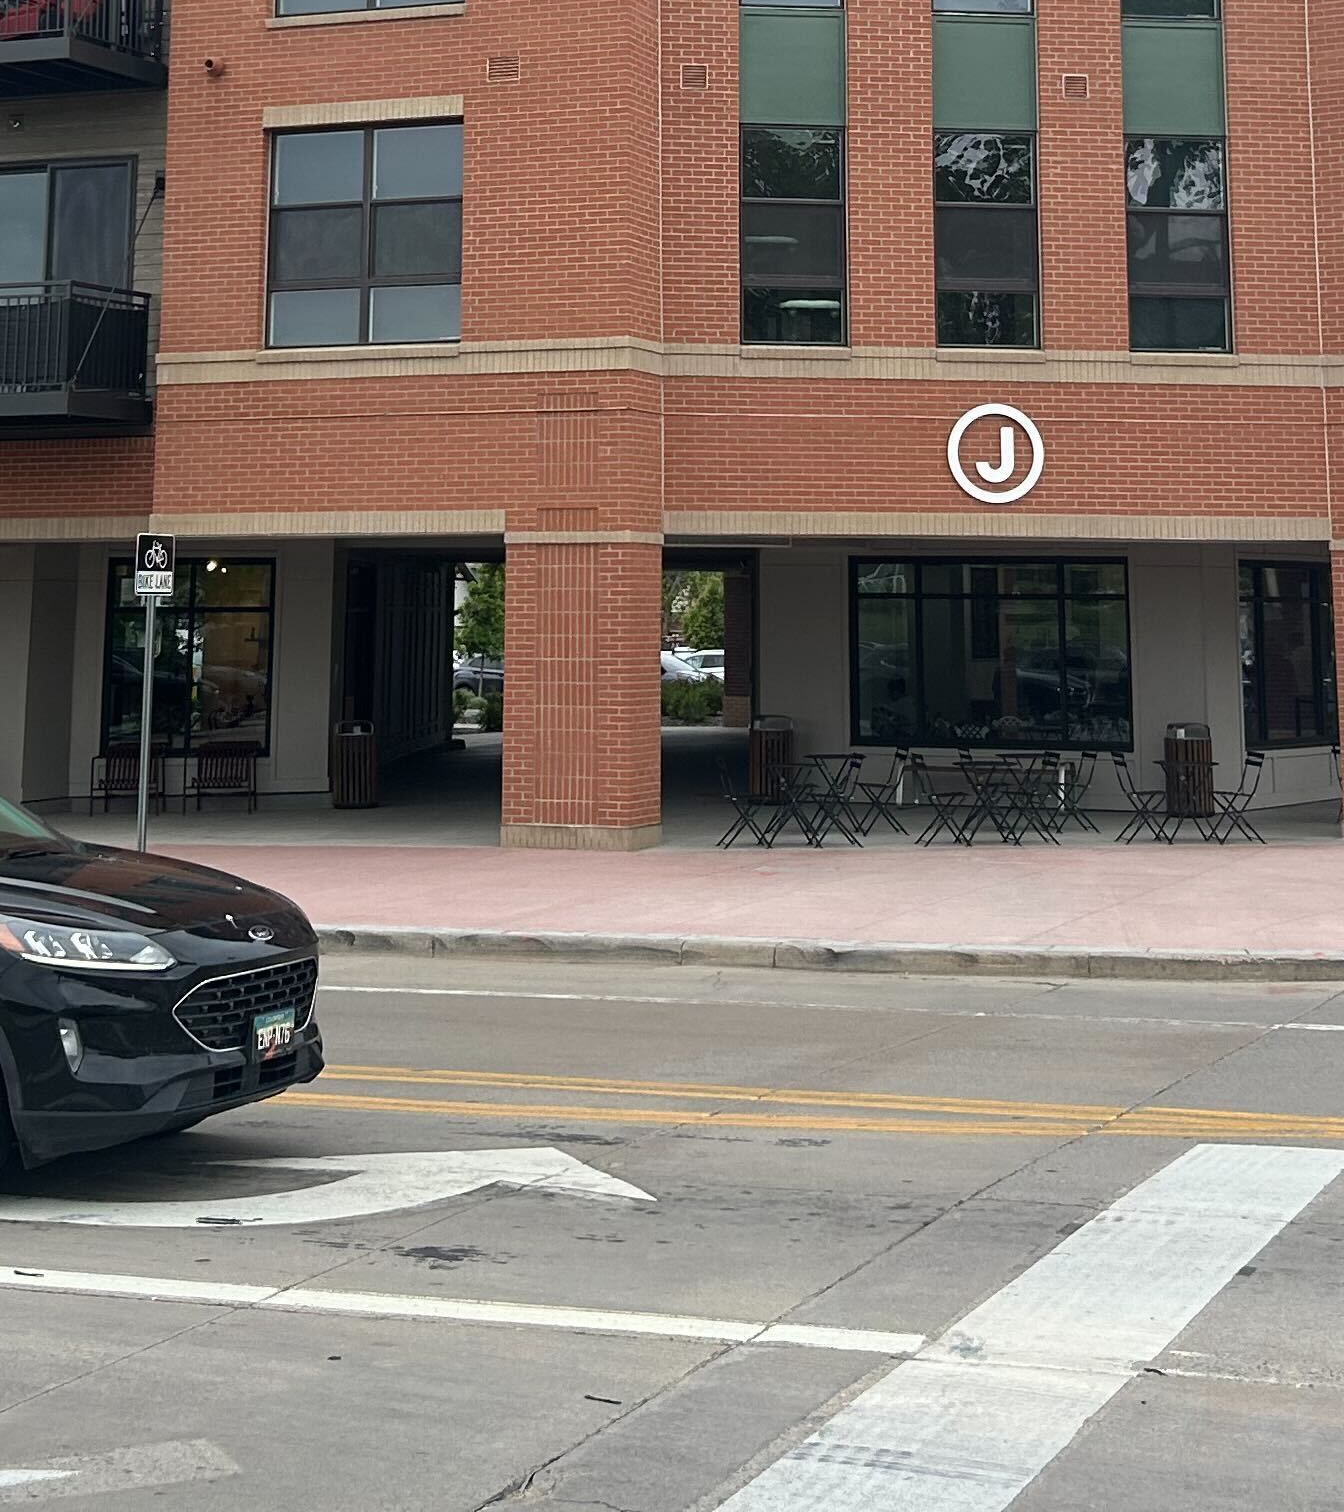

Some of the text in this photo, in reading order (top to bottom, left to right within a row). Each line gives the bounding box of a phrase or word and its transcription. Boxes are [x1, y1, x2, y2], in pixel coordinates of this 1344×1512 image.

[975, 426, 1015, 484] J
[138, 574, 172, 589] BIKE LANE
